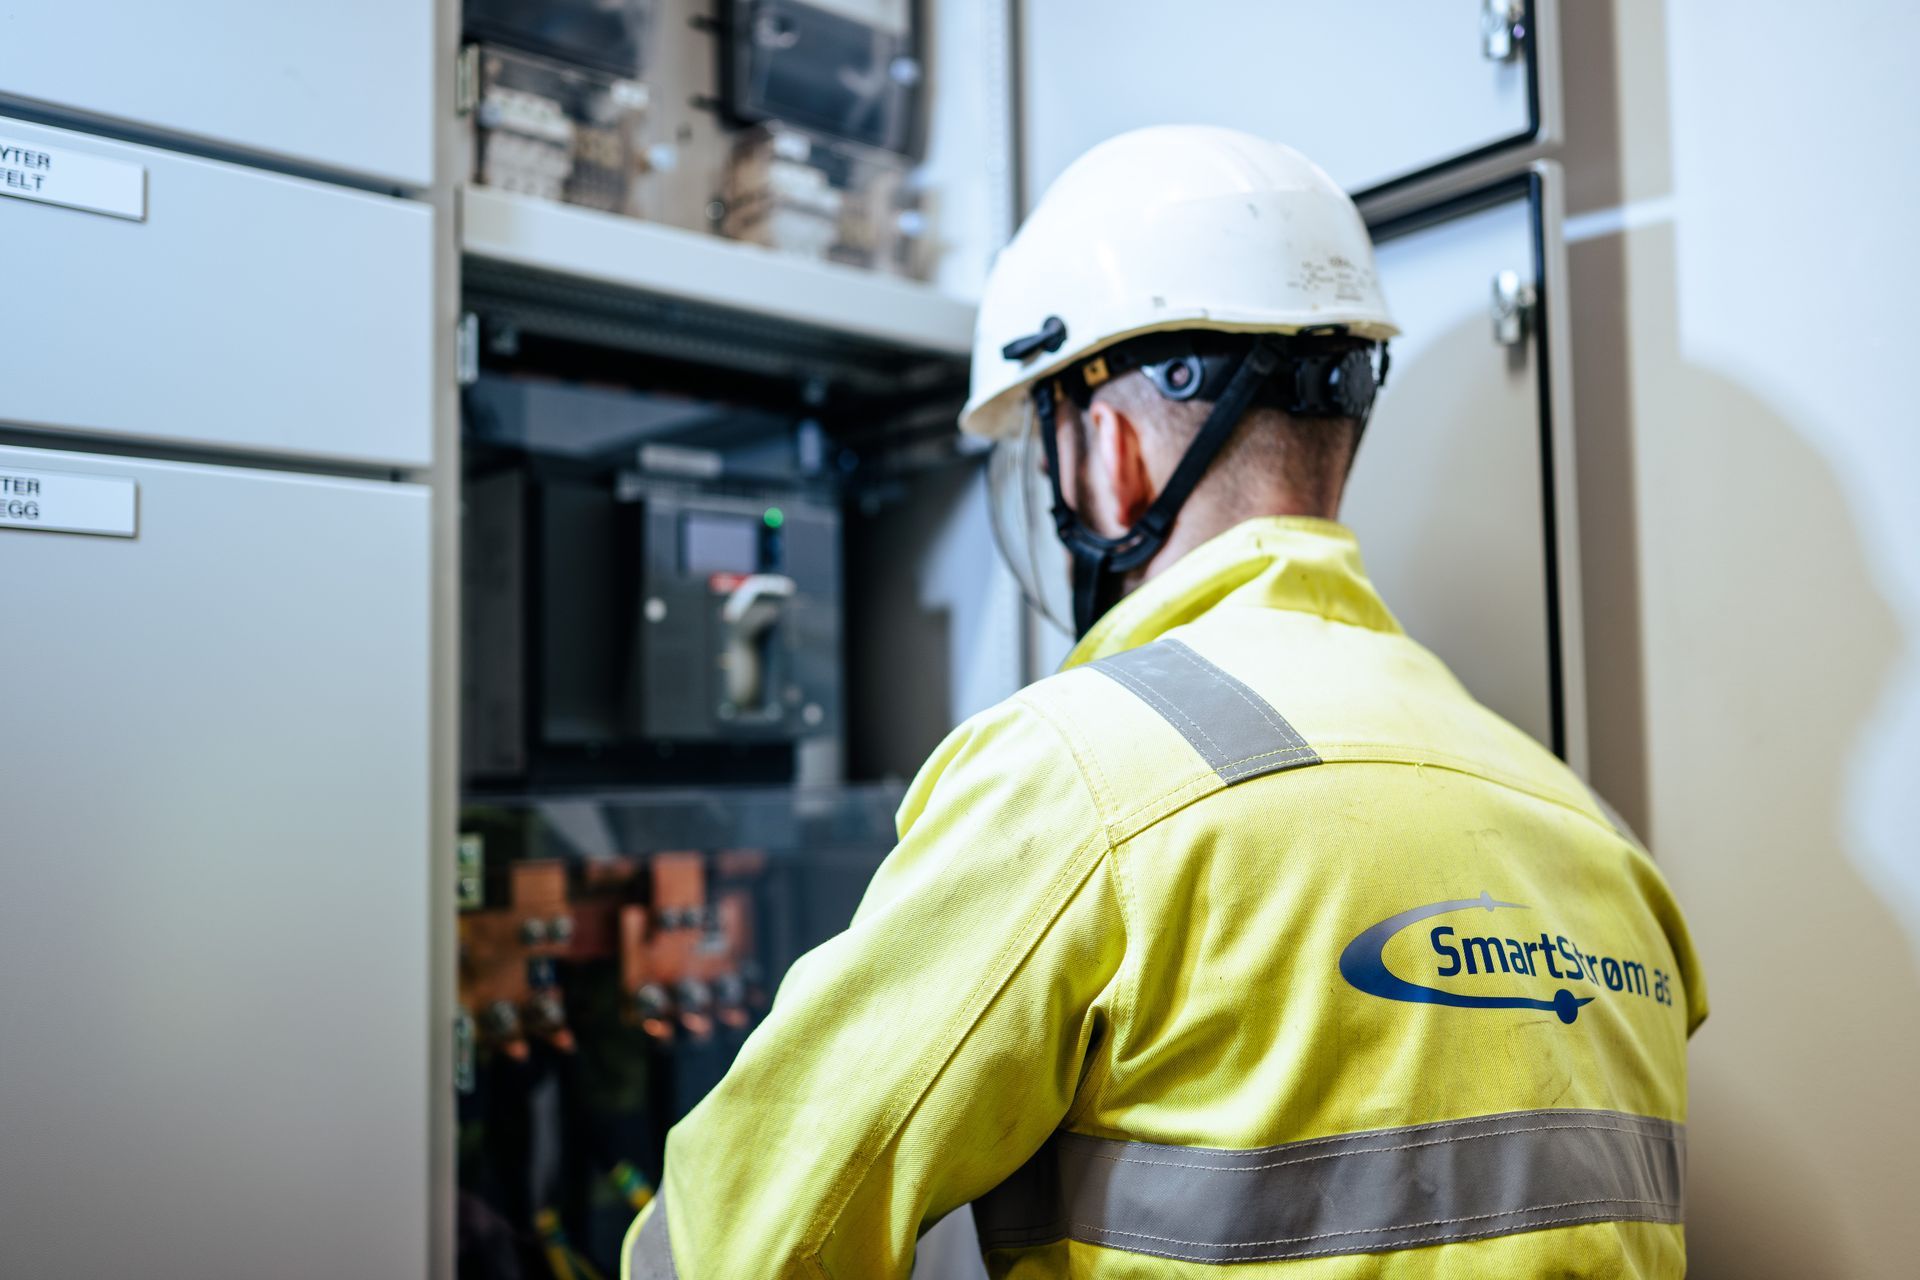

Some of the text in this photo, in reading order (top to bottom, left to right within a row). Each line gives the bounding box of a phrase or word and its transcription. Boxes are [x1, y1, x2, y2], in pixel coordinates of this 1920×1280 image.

[0, 476, 40, 496] TER
[1430, 926, 1672, 1007] SmartStrøm as
